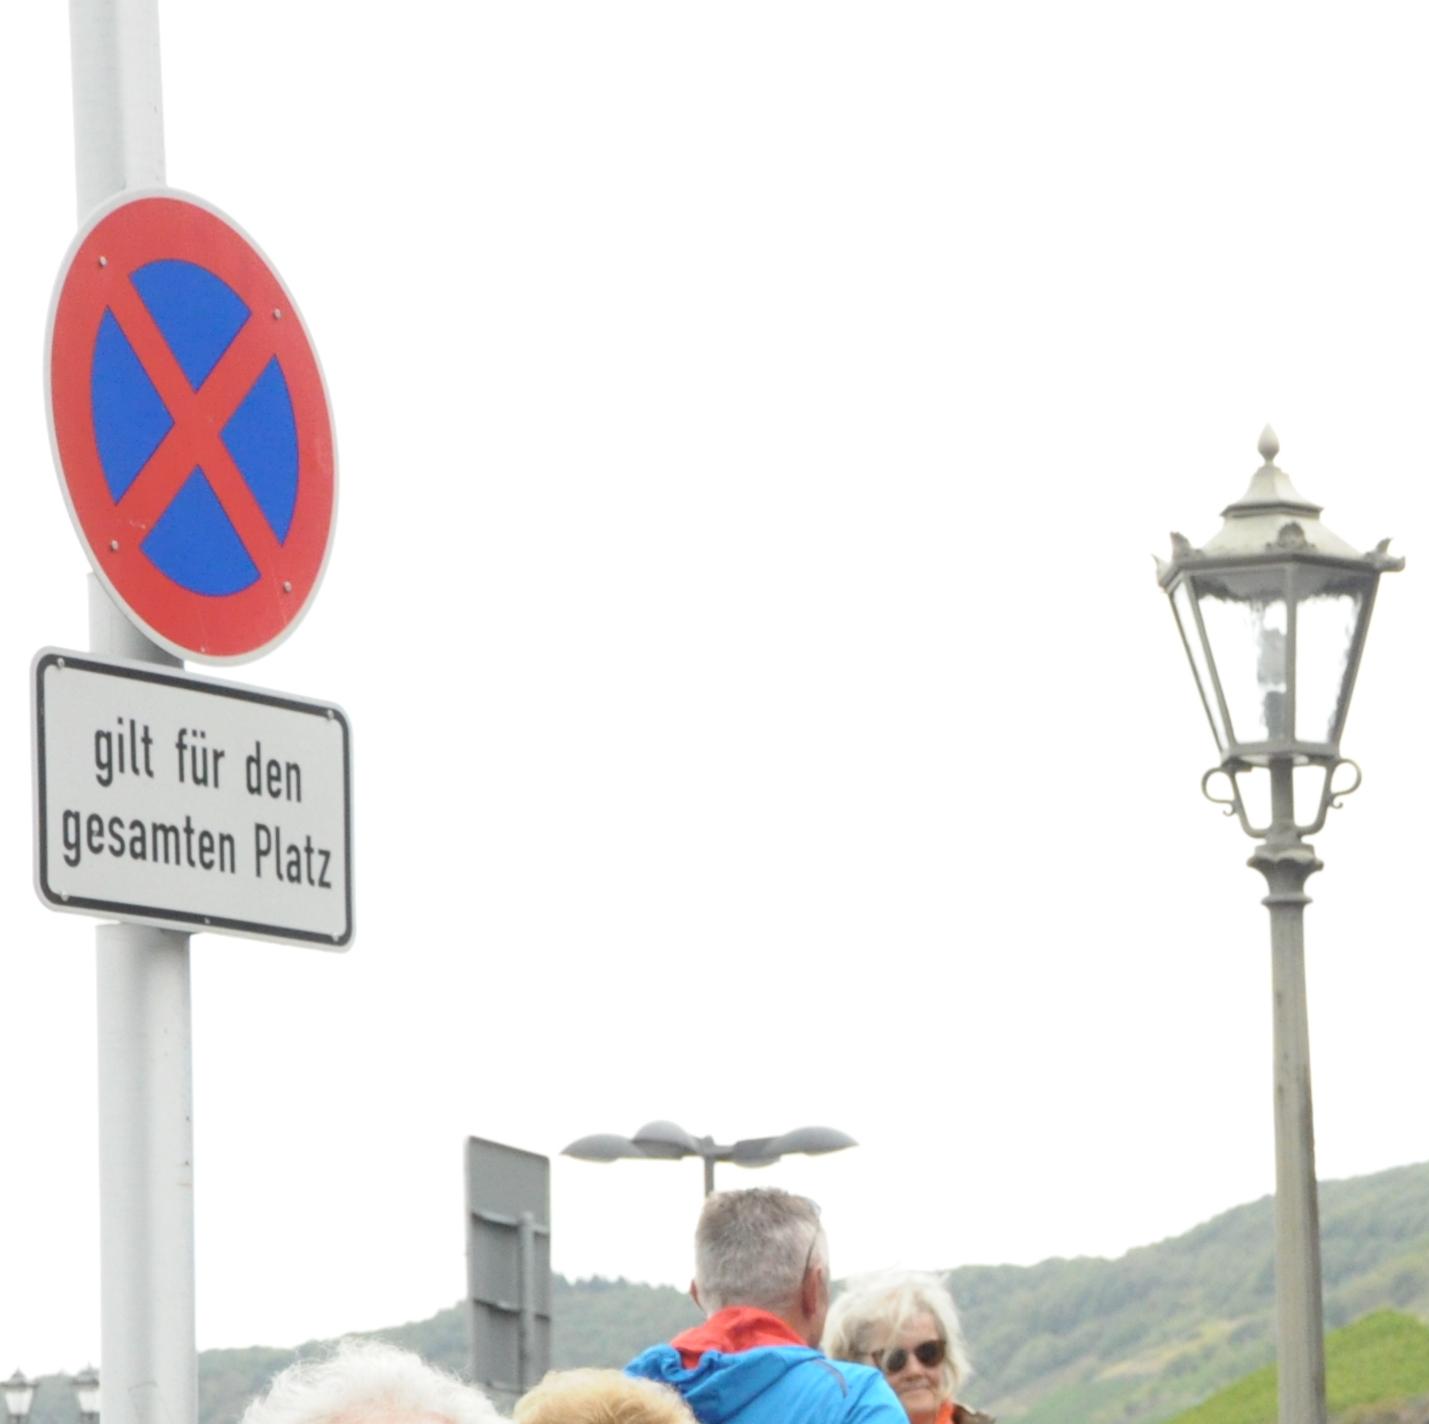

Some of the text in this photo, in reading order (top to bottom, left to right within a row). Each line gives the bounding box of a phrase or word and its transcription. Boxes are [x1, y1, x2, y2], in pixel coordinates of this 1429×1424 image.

[94, 716, 302, 803] gilt für den
[62, 809, 332, 889] gesamten Platz
